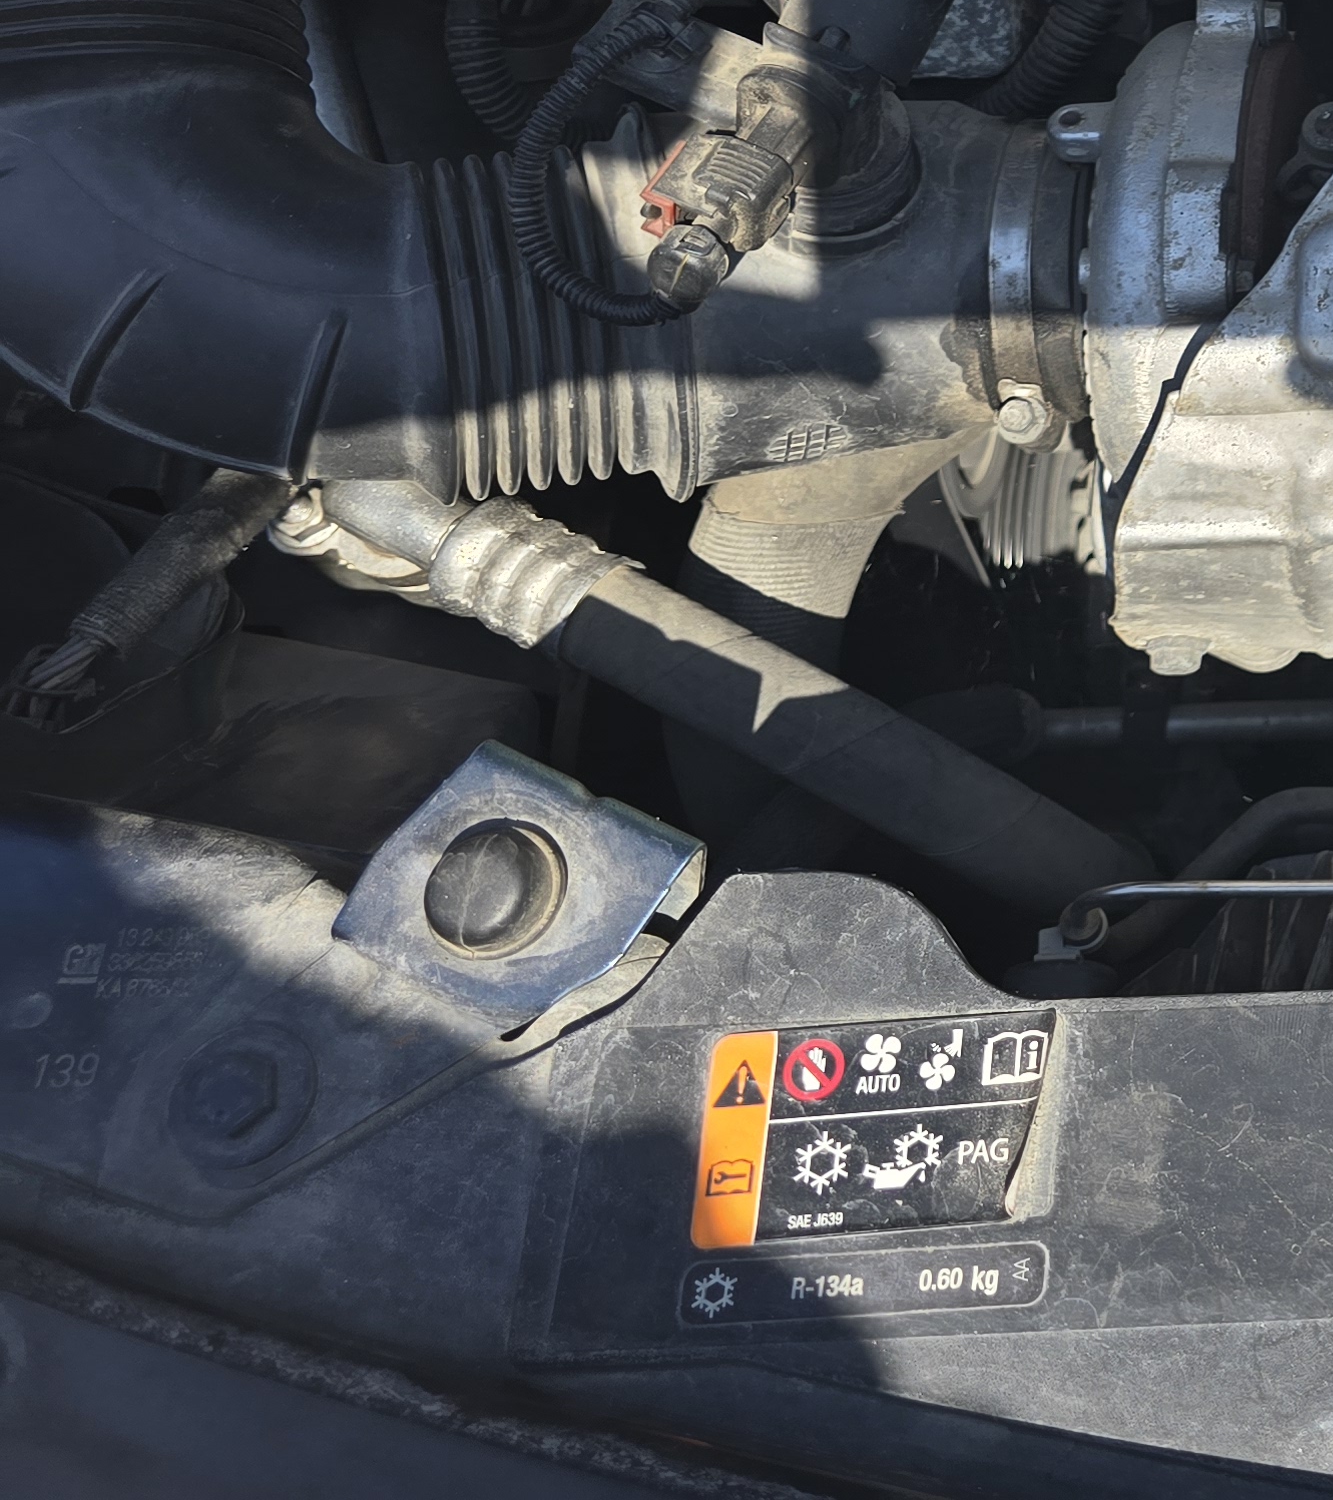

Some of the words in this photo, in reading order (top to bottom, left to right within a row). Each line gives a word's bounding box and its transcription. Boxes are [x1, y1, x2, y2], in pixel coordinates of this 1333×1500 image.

[35, 1052, 100, 1089] 139
[855, 1074, 901, 1095] AUTO
[957, 1138, 1010, 1165] PAG
[787, 1214, 812, 1230] SAE
[814, 1211, 844, 1229] J639
[790, 1274, 864, 1300] R-134a
[918, 1266, 963, 1293] 0.60
[971, 1265, 999, 1296] kg
